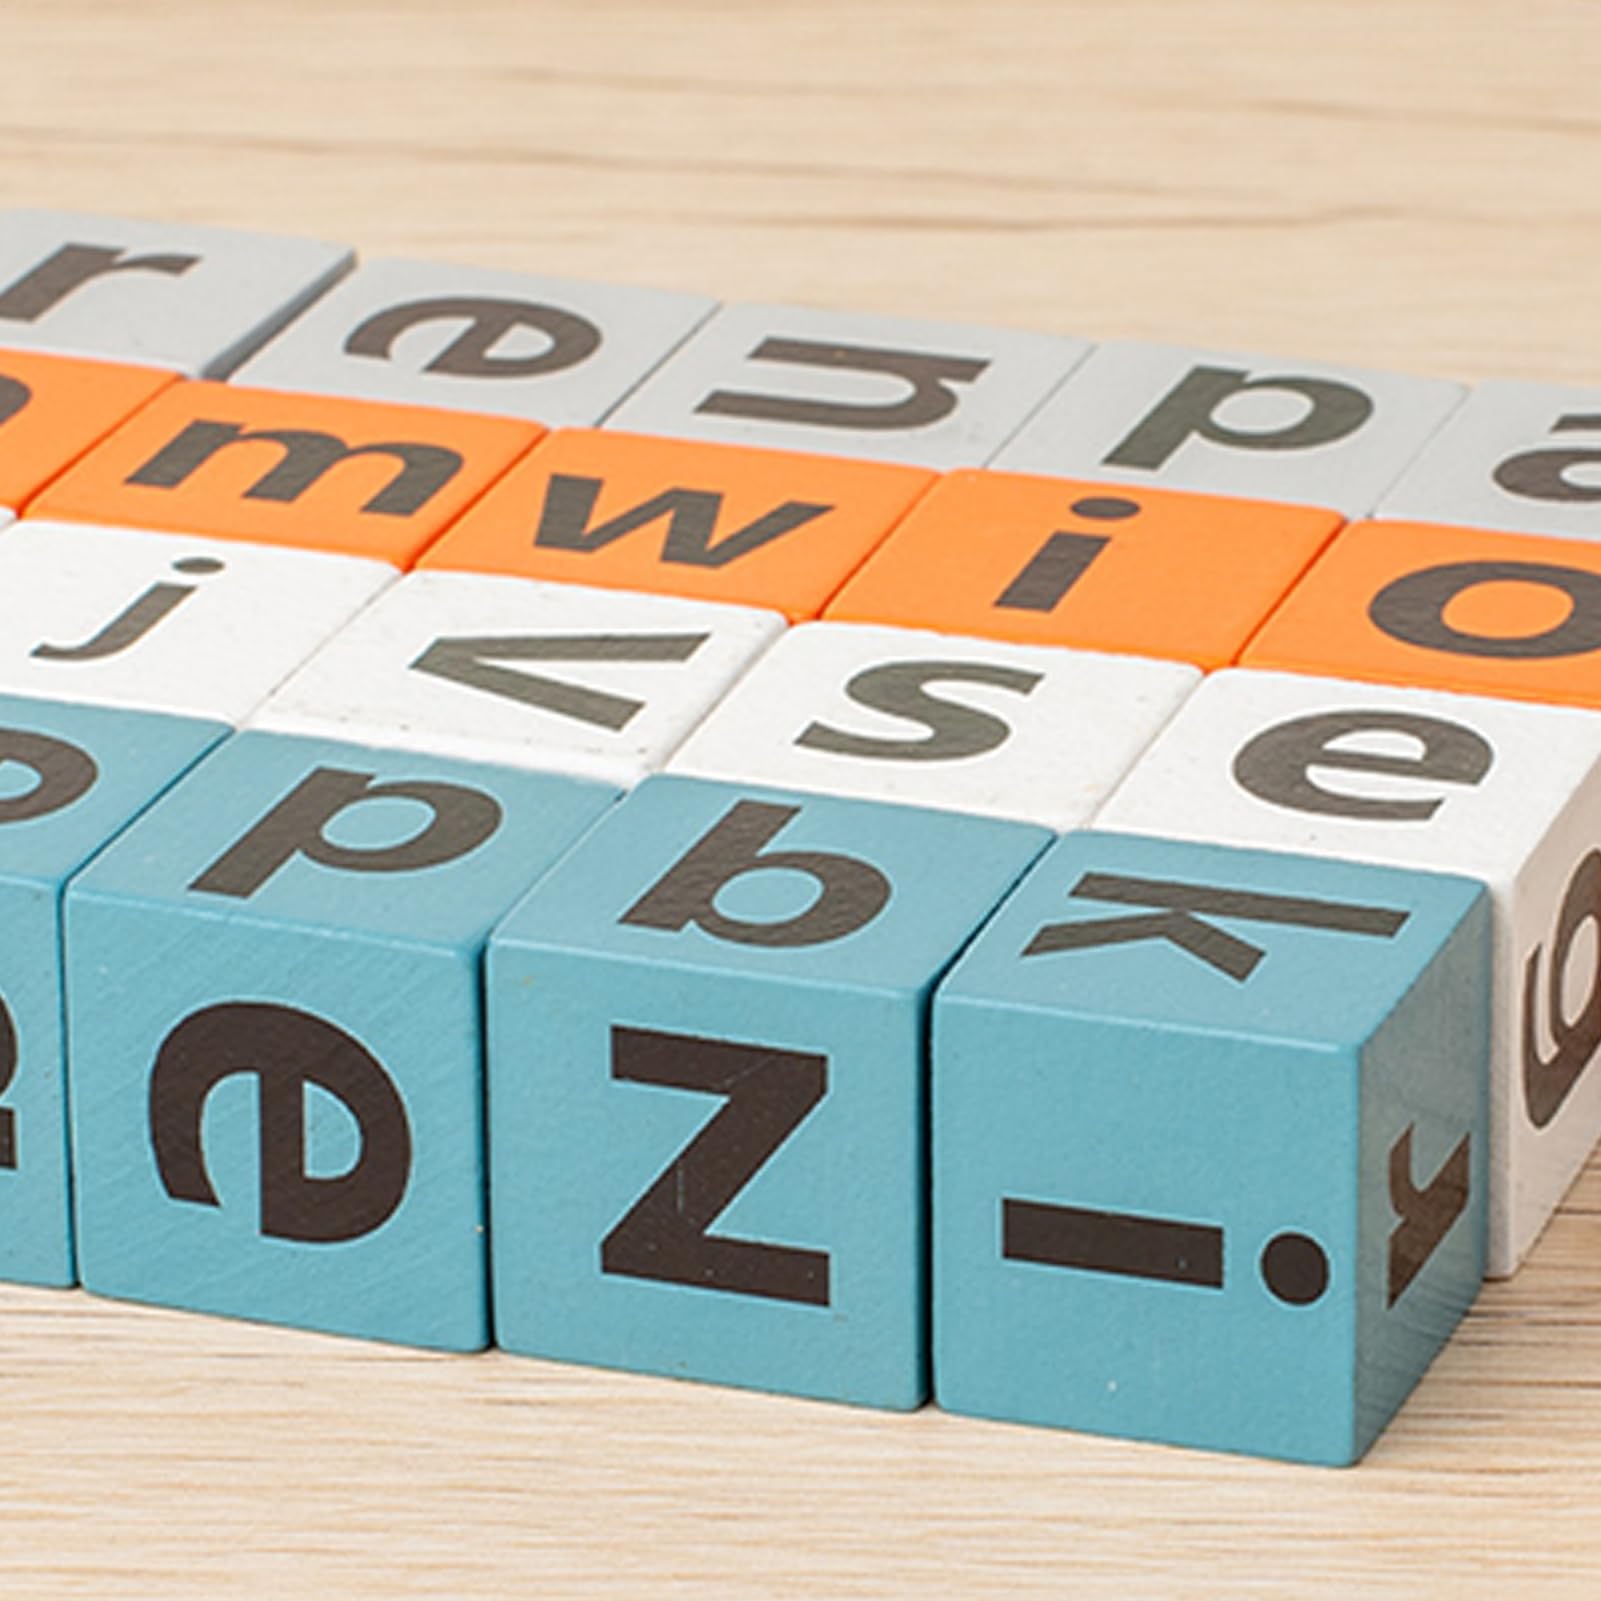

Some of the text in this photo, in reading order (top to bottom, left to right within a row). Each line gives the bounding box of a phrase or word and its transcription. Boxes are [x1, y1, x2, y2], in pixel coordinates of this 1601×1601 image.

[0, 243, 198, 322] r
[345, 297, 601, 377] e
[127, 420, 463, 515] m
[1102, 367, 1374, 471] p
[534, 473, 831, 569] w
[996, 498, 1140, 611] i
[31, 557, 224, 661] j
[795, 659, 1043, 761] s
[1234, 709, 1493, 820] e
[187, 766, 503, 899] p
[618, 800, 892, 949] b
[1021, 872, 1410, 982] k
[148, 1000, 413, 1245] e
[1001, 1196, 1331, 1307] i
[1387, 1121, 1472, 1310] r
